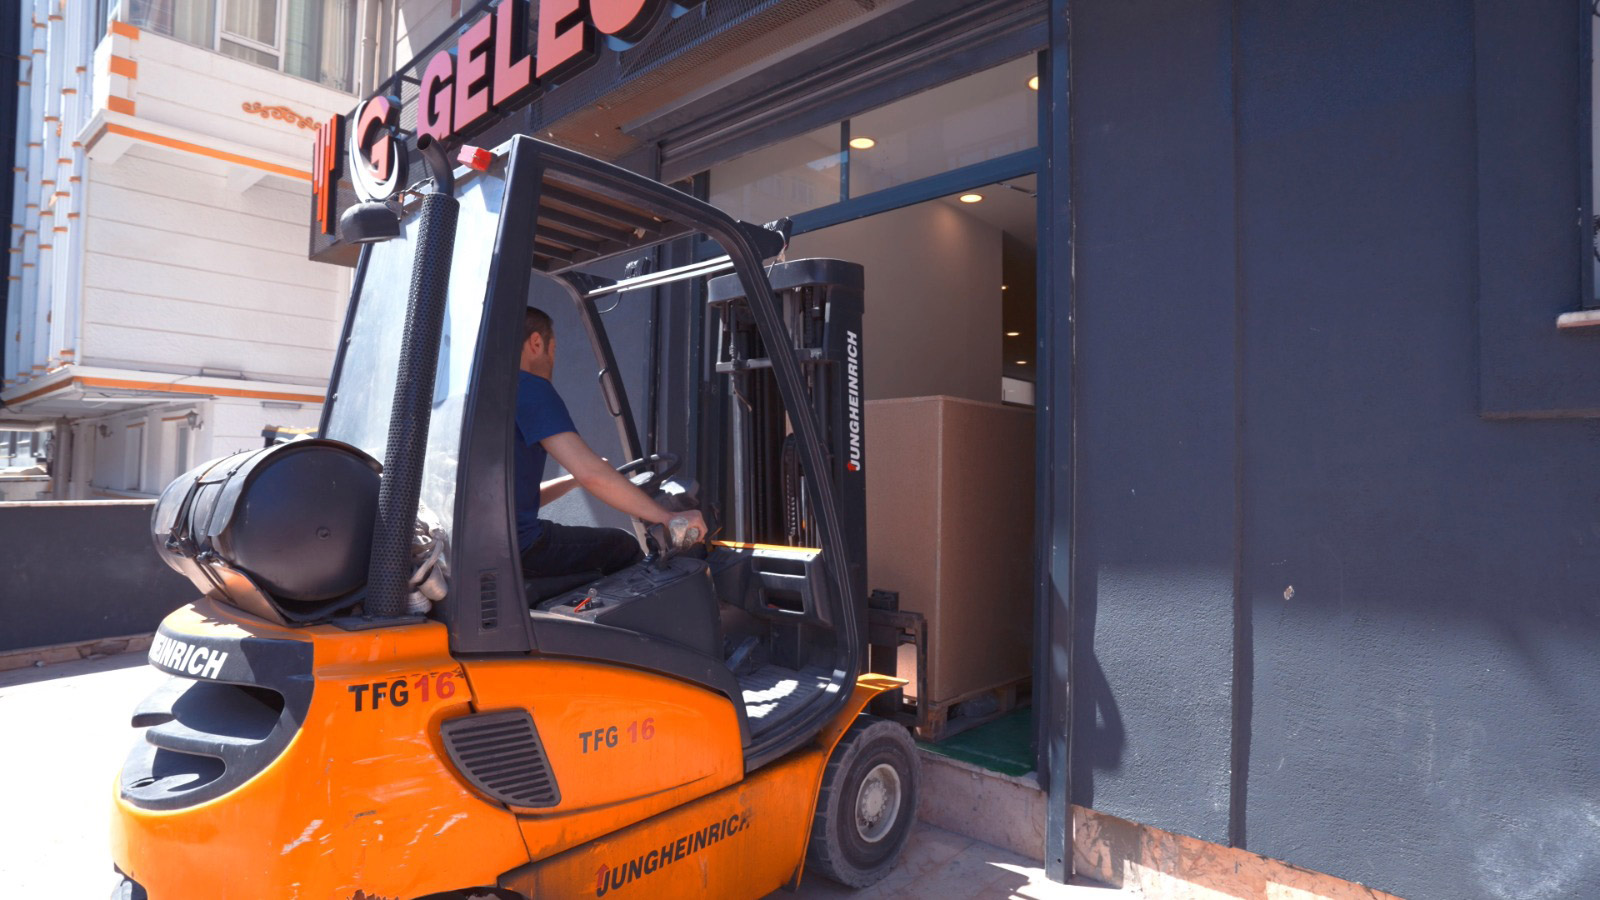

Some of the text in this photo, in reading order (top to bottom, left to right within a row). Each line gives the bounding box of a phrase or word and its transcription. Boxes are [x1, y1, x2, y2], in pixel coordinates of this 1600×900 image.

[357, 95, 390, 181] G
[847, 330, 861, 471] JUNGHEINRICH
[348, 671, 456, 712] TFG 16
[578, 717, 655, 754] TFG 16
